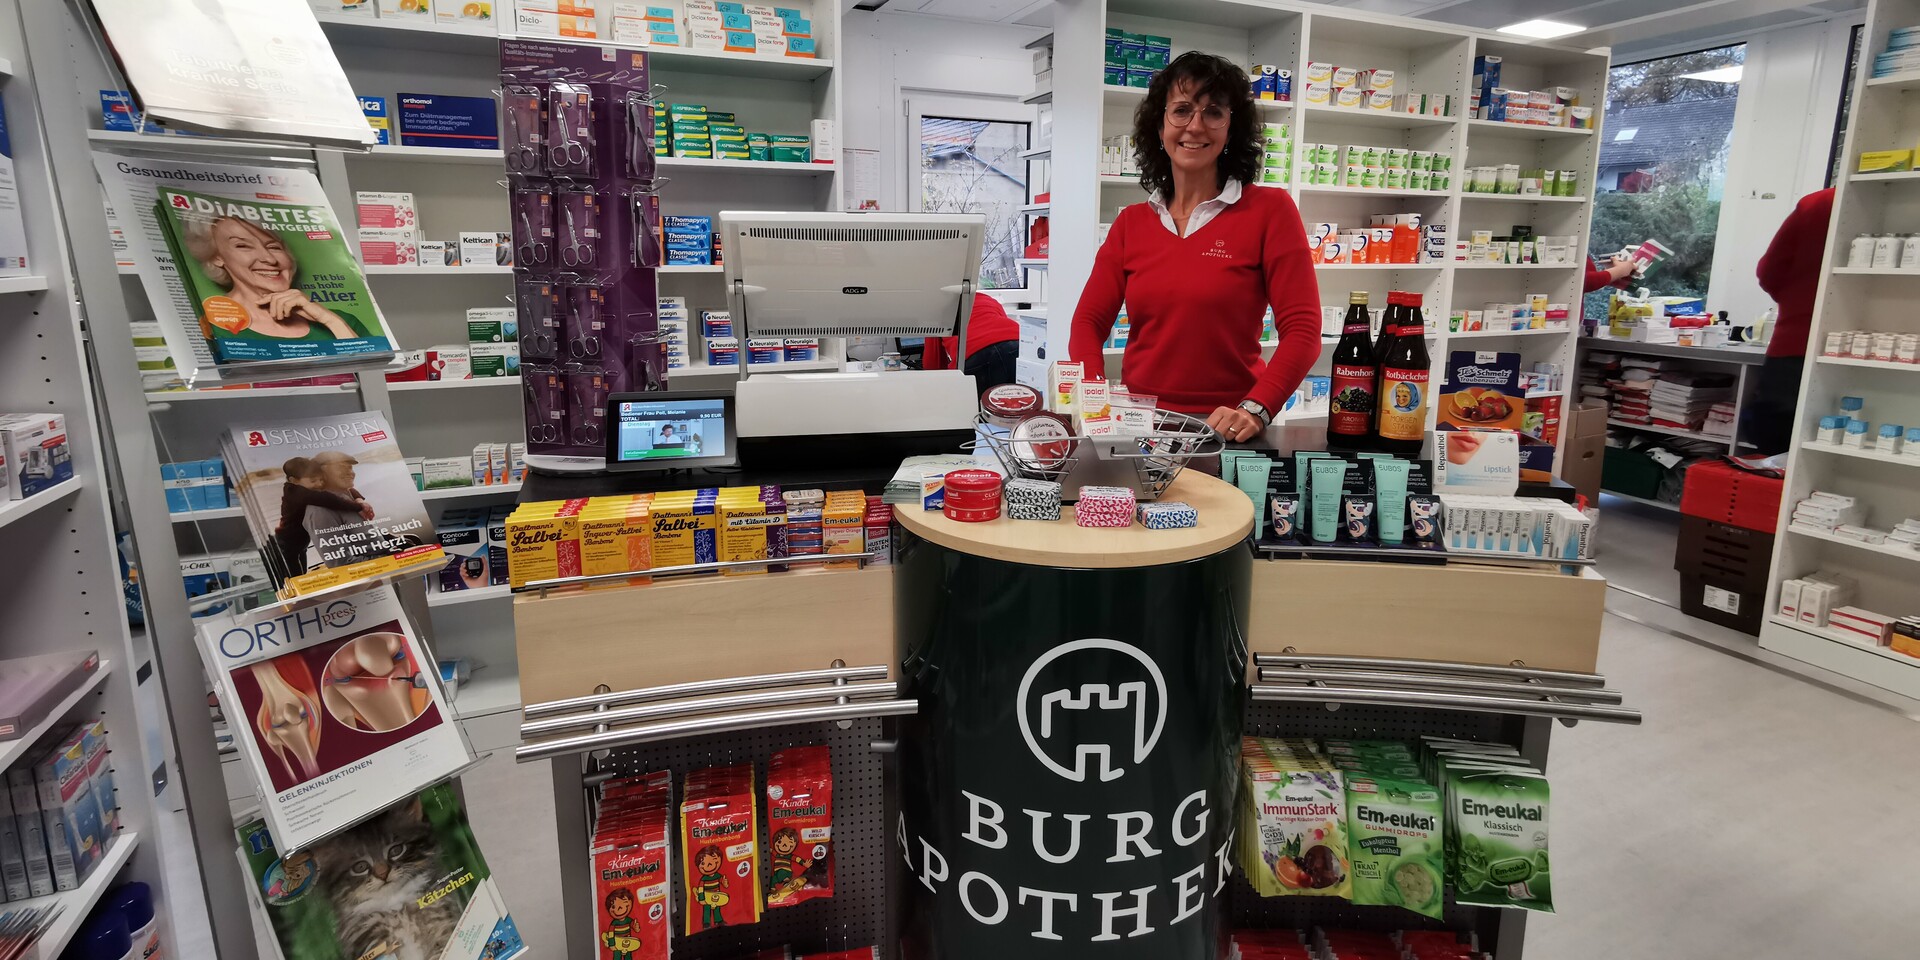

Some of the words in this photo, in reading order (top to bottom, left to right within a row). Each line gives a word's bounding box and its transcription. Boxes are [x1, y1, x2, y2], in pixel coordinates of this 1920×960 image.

[520, 14, 543, 25] Diclo-
[504, 42, 520, 50] Fragen
[169, 63, 241, 89] kranke
[361, 97, 383, 112] ica
[402, 97, 433, 105] orthomol
[420, 112, 473, 122] Diätmanagement
[1506, 108, 1528, 116] RIOPAN
[416, 118, 438, 126] nutritiv
[438, 120, 471, 128] bedingten
[116, 162, 262, 186] Gesundheitsbrief
[670, 216, 709, 224] Thomapyrin
[262, 222, 328, 232] RATGEBER
[462, 236, 494, 244] Keltican
[668, 232, 706, 240] Thomapyrin
[154, 256, 176, 264] Wie
[312, 274, 330, 282] Fit
[332, 274, 346, 282] bis
[300, 282, 316, 290] ins
[318, 280, 344, 290] hohe
[310, 290, 357, 304] Alter
[754, 340, 778, 348] Neuralgin
[1476, 370, 1511, 378] Schmelz
[1084, 388, 1104, 396] ipalat
[1390, 415, 1418, 424] MORGEN
[1090, 426, 1111, 434] ipalat
[1392, 422, 1413, 430] STARK
[268, 419, 382, 447] SENIOREN
[295, 440, 345, 451] RATGEBER
[1437, 434, 1446, 471] Bepanthol
[1240, 464, 1264, 472] EUBOS
[1316, 466, 1338, 474] EUBOS
[1378, 464, 1402, 472] EUBOS
[1484, 465, 1512, 474] Lipstick
[652, 510, 692, 519] Dallmann's
[726, 510, 766, 519] Dallmann's
[314, 522, 362, 535] Entzündliches
[363, 516, 392, 527] Rheuma
[510, 522, 554, 532] Dallmann's
[582, 521, 626, 531] Dallmann's
[652, 518, 705, 532] Salbei-
[744, 518, 772, 526] Vitamin
[318, 532, 368, 549] Achten
[370, 527, 390, 540] Sie
[390, 518, 423, 535] auch
[583, 527, 646, 539] Ingwer-Salbei-
[1542, 512, 1554, 546] Bepanthol
[510, 528, 568, 546] Salbei-
[584, 537, 615, 546] Bonbons
[1578, 524, 1590, 558] Bepanthol
[323, 548, 348, 565] auf
[349, 542, 368, 557] Ihr
[370, 535, 408, 552] Herz!
[512, 545, 544, 554] Bonbons
[320, 604, 357, 626] press
[278, 758, 374, 804] GELENKINJEKTIONEN
[778, 798, 812, 808] Kinder
[1263, 802, 1338, 816] ImmunStark
[694, 817, 732, 828] Kinder
[961, 789, 1211, 864] BURG
[1484, 820, 1523, 832] Klassisch
[1365, 824, 1428, 839] GUMMIDROPS
[700, 834, 741, 844] Hustenbonbons
[1361, 838, 1396, 848] Eukalyptus
[1372, 847, 1400, 855] Menthol
[608, 854, 646, 870] Kinder
[610, 874, 653, 887] Hustenbonbons
[896, 810, 1236, 942] APOTHEK
[416, 871, 475, 910] Kätzchen
